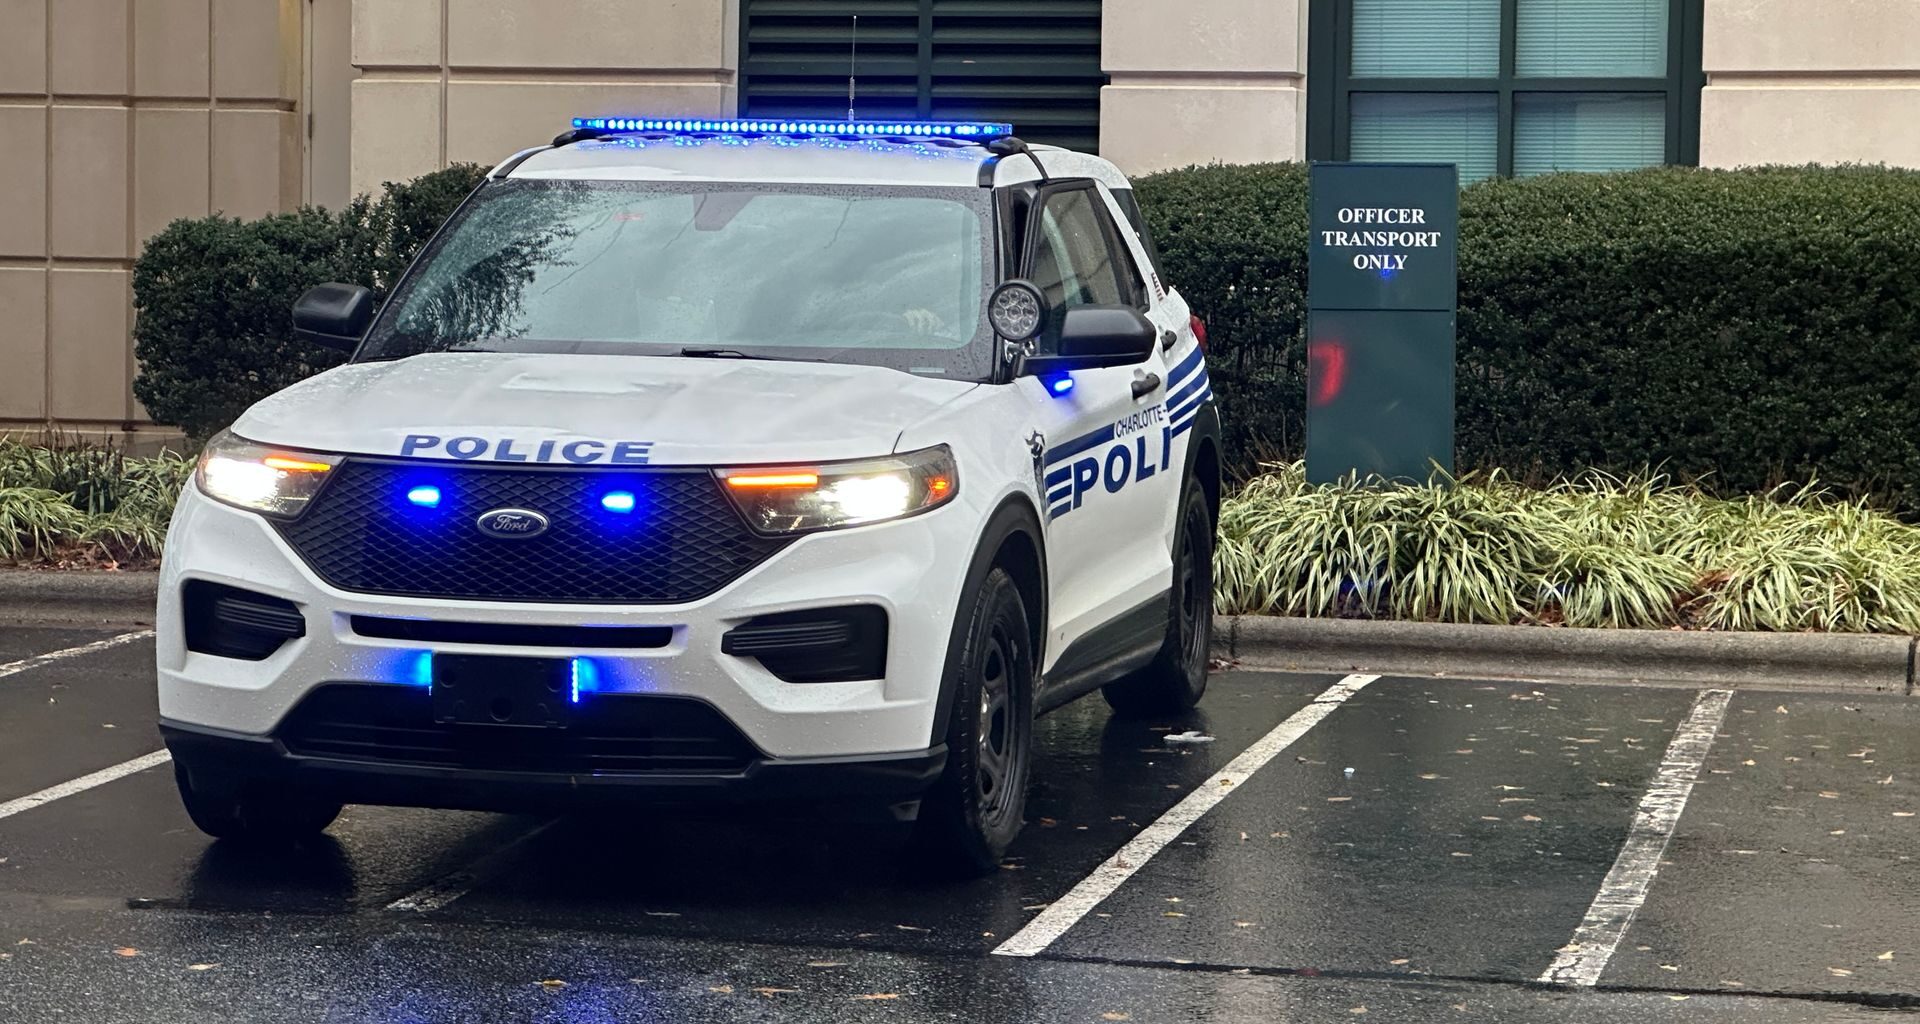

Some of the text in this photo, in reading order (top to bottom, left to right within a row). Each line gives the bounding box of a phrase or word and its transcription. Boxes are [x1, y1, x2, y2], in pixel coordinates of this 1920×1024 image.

[1338, 208, 1425, 224] OFFICER
[1322, 231, 1441, 247] TRANSPORT
[1353, 254, 1408, 270] ONLY
[400, 434, 654, 464] POLICE
[492, 514, 530, 533] Ford
